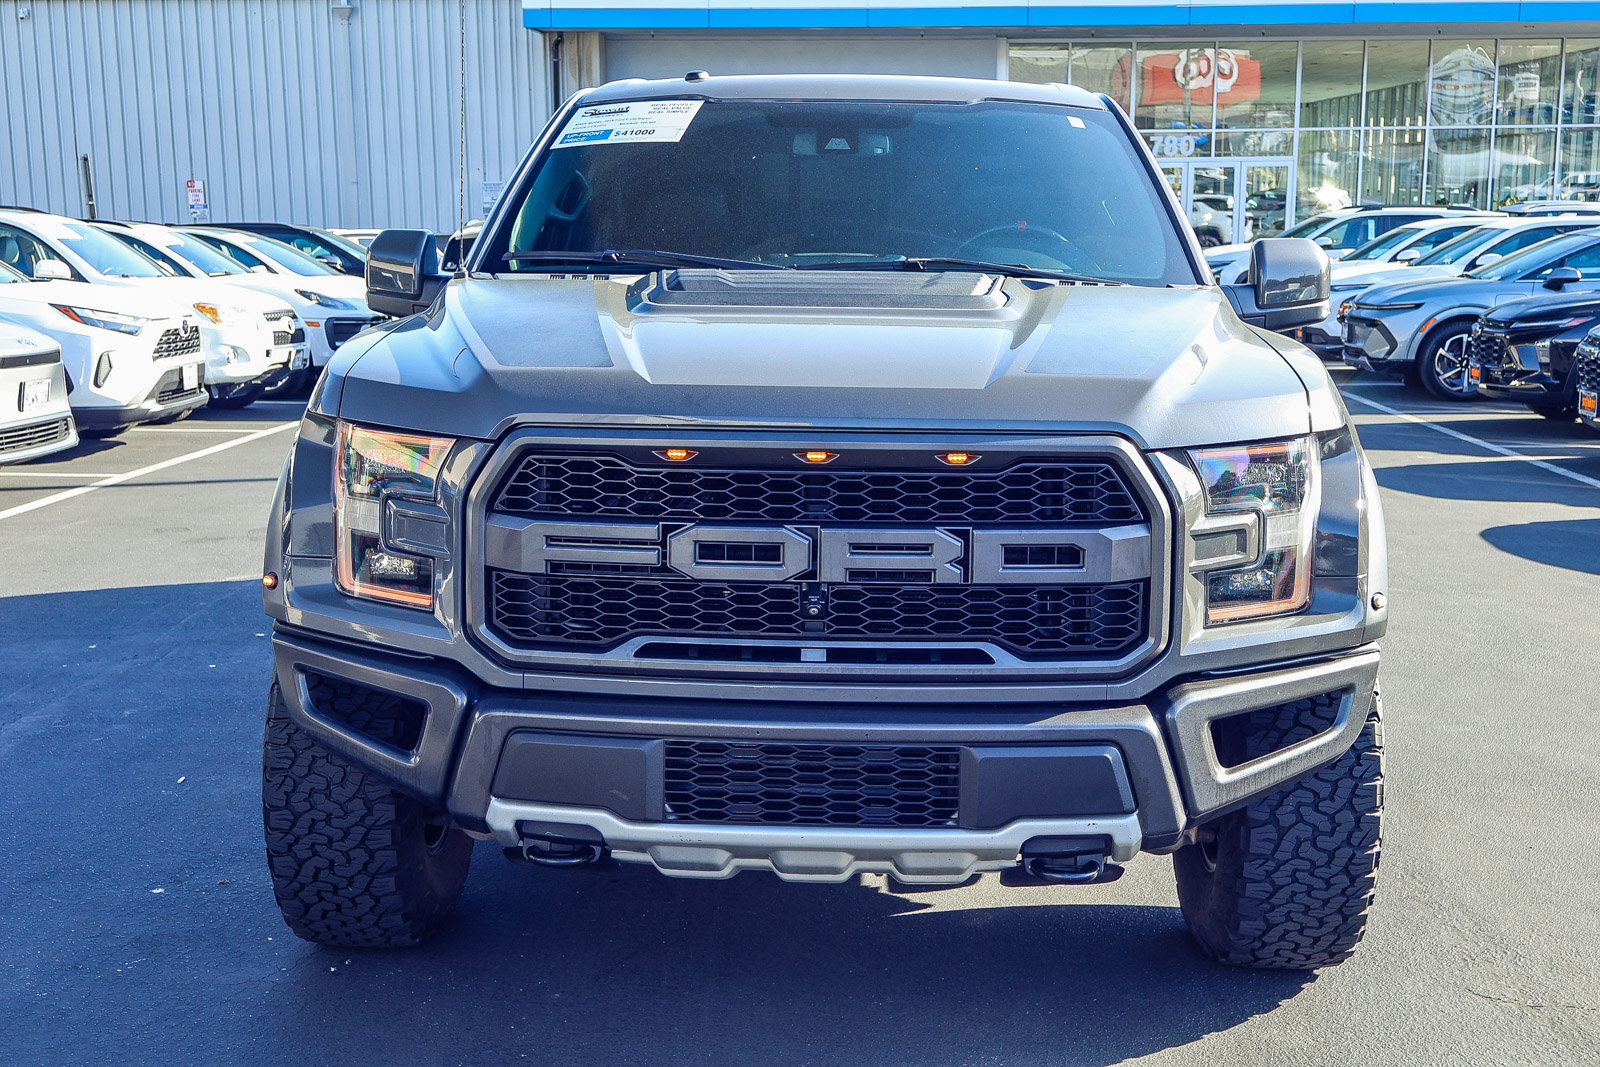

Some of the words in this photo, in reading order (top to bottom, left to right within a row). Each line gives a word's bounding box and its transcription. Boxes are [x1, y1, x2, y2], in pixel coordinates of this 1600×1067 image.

[582, 106, 630, 117] Stewart
[567, 130, 605, 139] UP-FRONT
[1149, 135, 1196, 157] 780
[486, 514, 1151, 583] FORD
